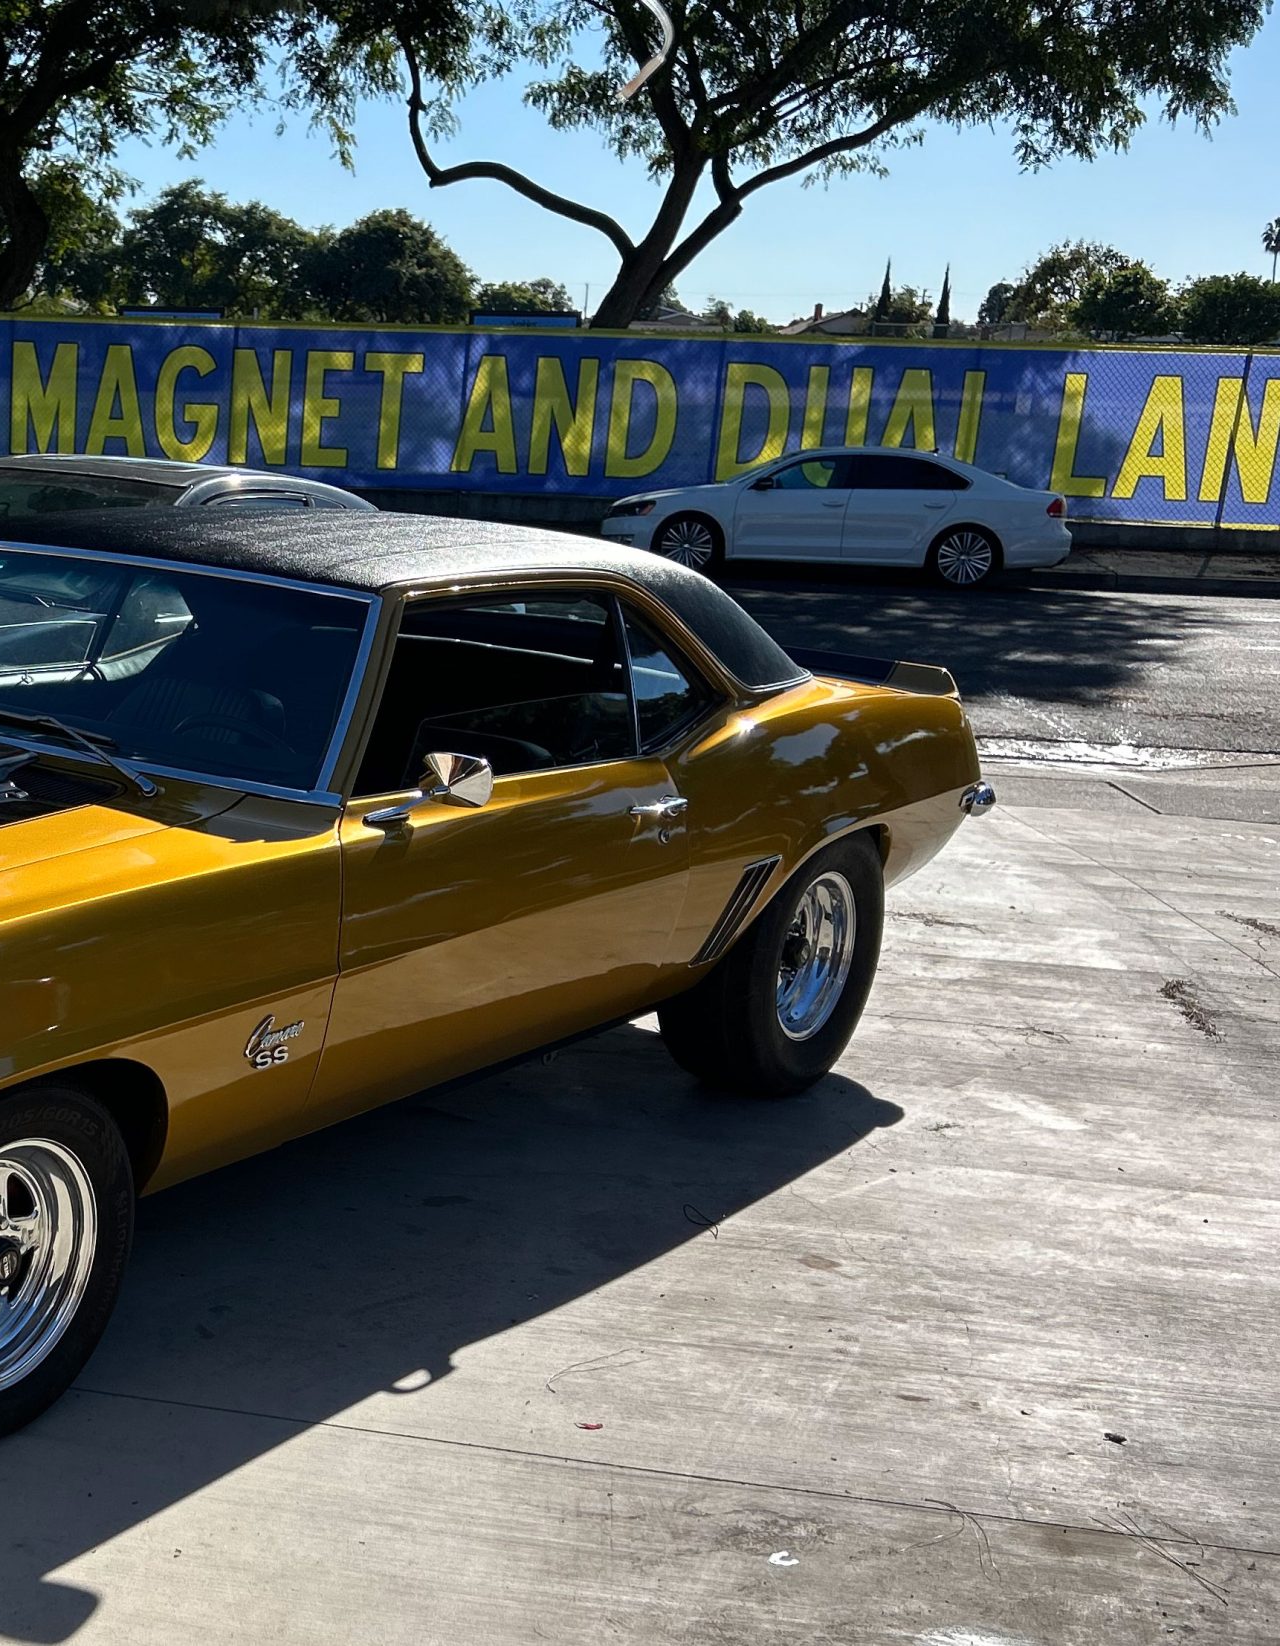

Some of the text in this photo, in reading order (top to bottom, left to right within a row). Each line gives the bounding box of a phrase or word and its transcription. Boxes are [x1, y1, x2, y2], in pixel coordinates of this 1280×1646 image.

[9, 340, 425, 470] MAGNET
[449, 354, 678, 479] AND
[714, 361, 1008, 484] DUAL
[1049, 372, 1280, 504] LAN
[255, 1045, 289, 1071] SS
